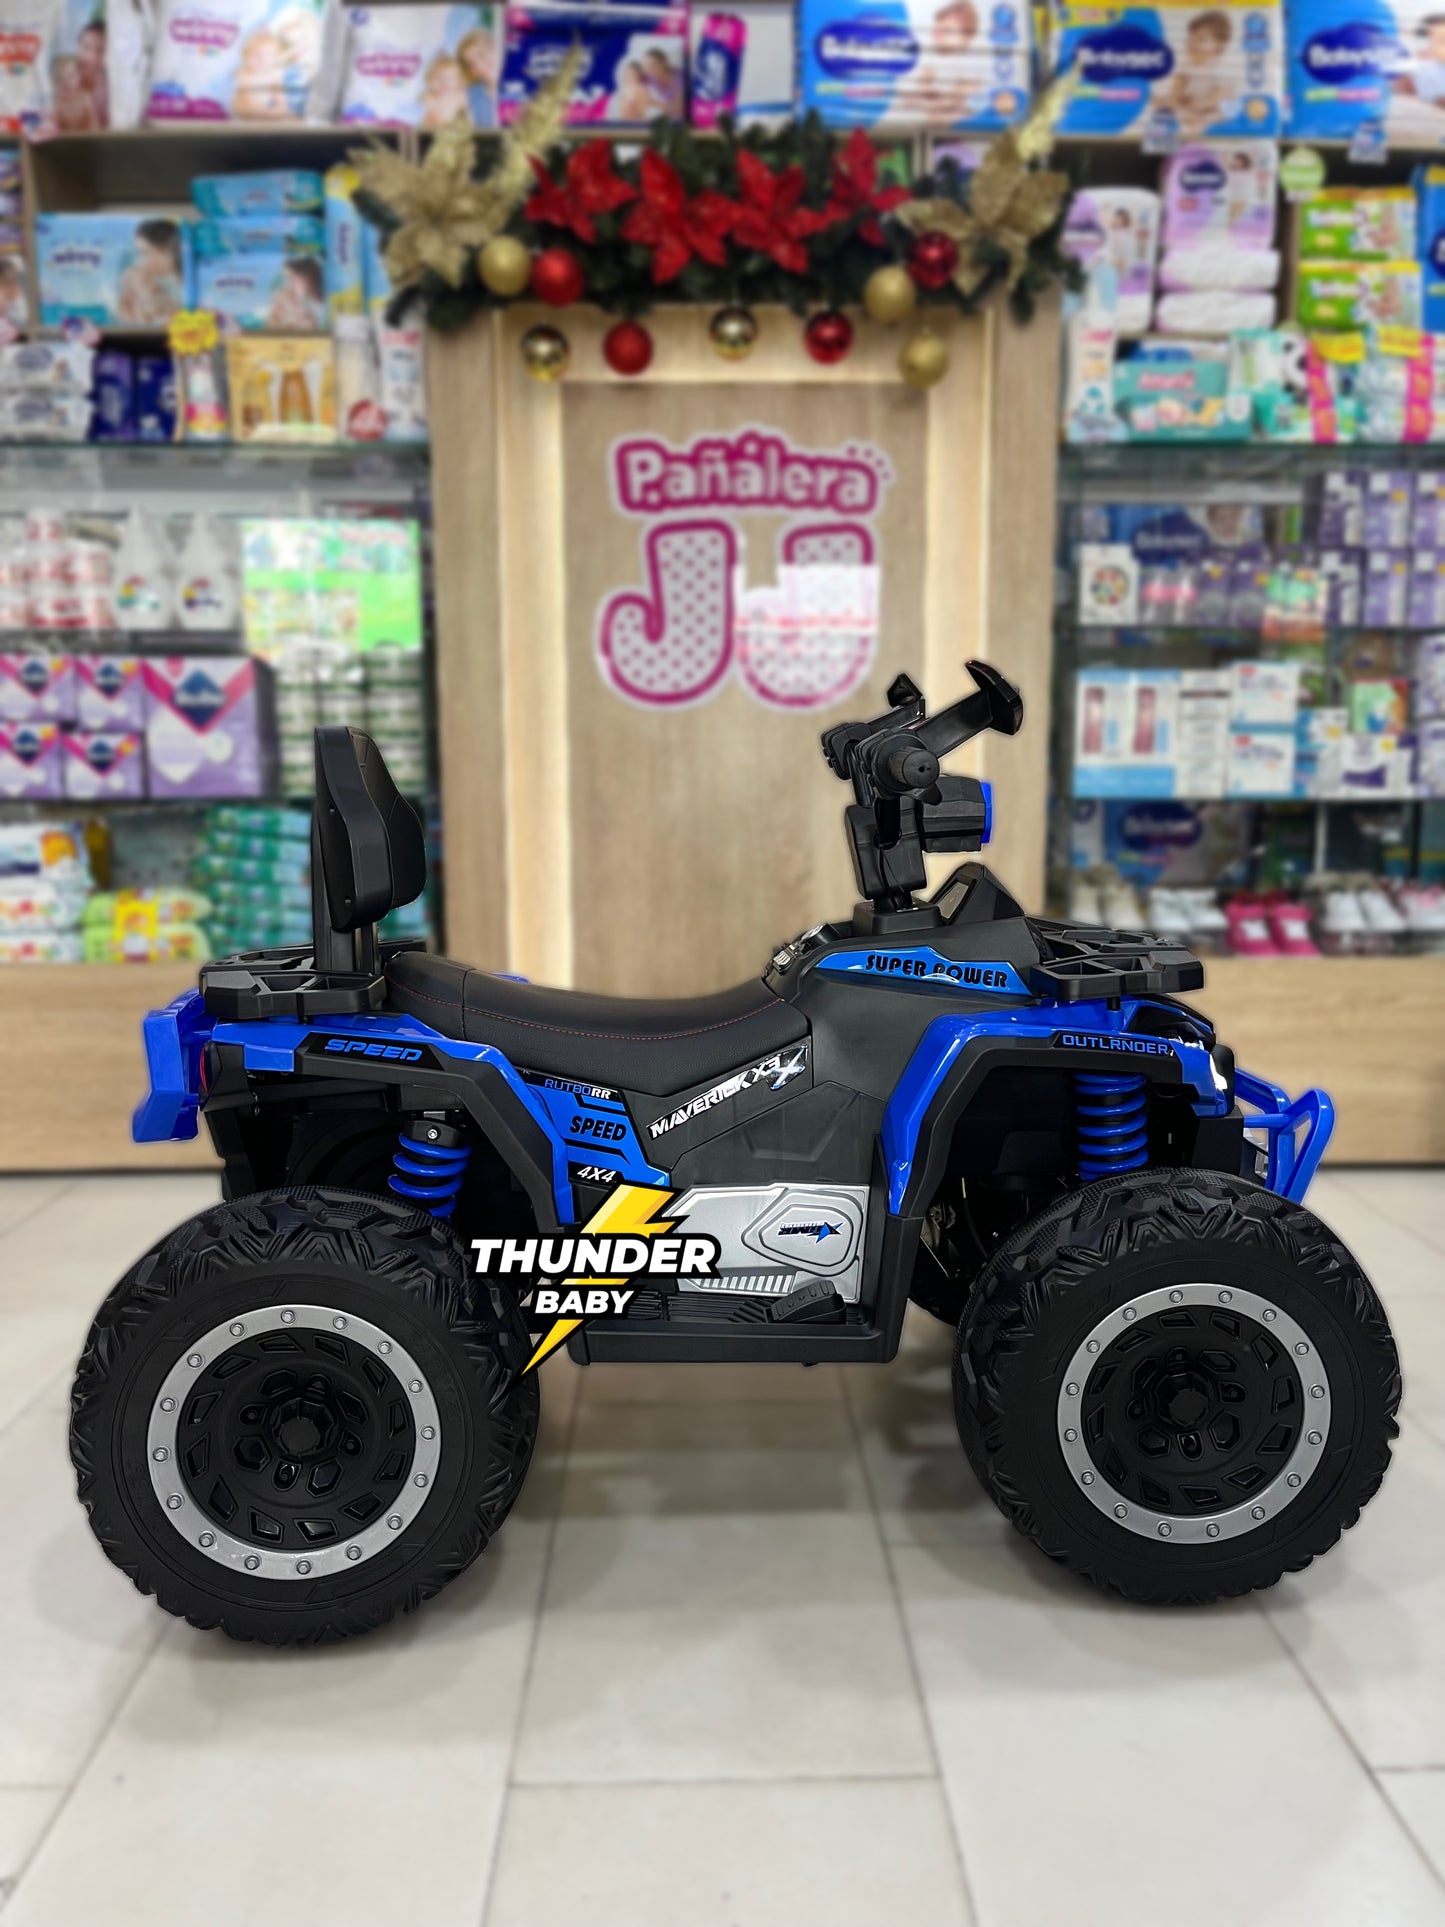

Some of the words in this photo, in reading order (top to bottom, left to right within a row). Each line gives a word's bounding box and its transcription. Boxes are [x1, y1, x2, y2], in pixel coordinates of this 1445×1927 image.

[865, 954, 927, 977] SUPER
[932, 962, 1008, 988] POWER
[324, 1039, 423, 1061] SPEED
[569, 1115, 627, 1141] SPEED
